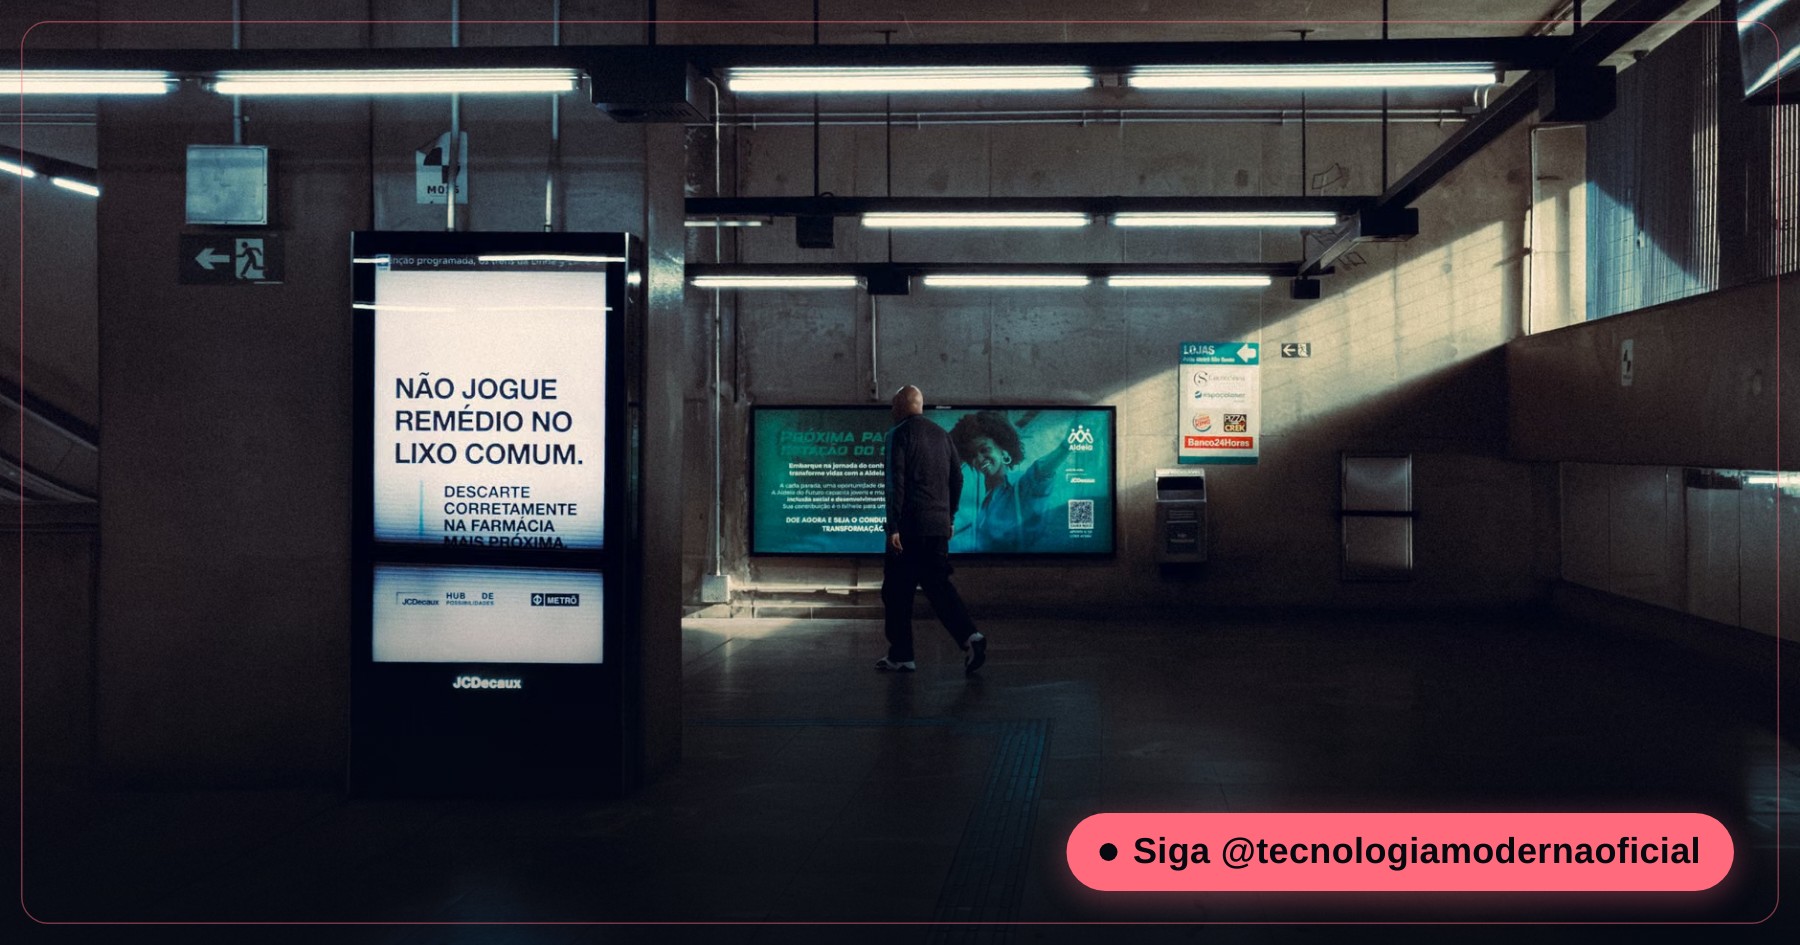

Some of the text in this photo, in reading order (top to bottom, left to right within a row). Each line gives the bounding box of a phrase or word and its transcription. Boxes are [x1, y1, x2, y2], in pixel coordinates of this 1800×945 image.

[416, 257, 476, 266] programada,
[1183, 345, 1215, 355] LOJAS
[395, 372, 557, 400] NÃO JOGUE
[395, 404, 573, 432] REMÉDIO NO
[1188, 439, 1250, 447] Banco24Horas
[395, 442, 583, 465] LIXO COMUM.
[444, 486, 530, 498] DESCARTE
[444, 503, 577, 515] CORRETAMENTE
[444, 516, 555, 532] NA FARMÁCIA
[444, 533, 568, 549] MAIS PRÓXIMA.
[402, 592, 577, 606] JCDecaux HUB DE METRÔ
[453, 677, 522, 689] JCDecaux
